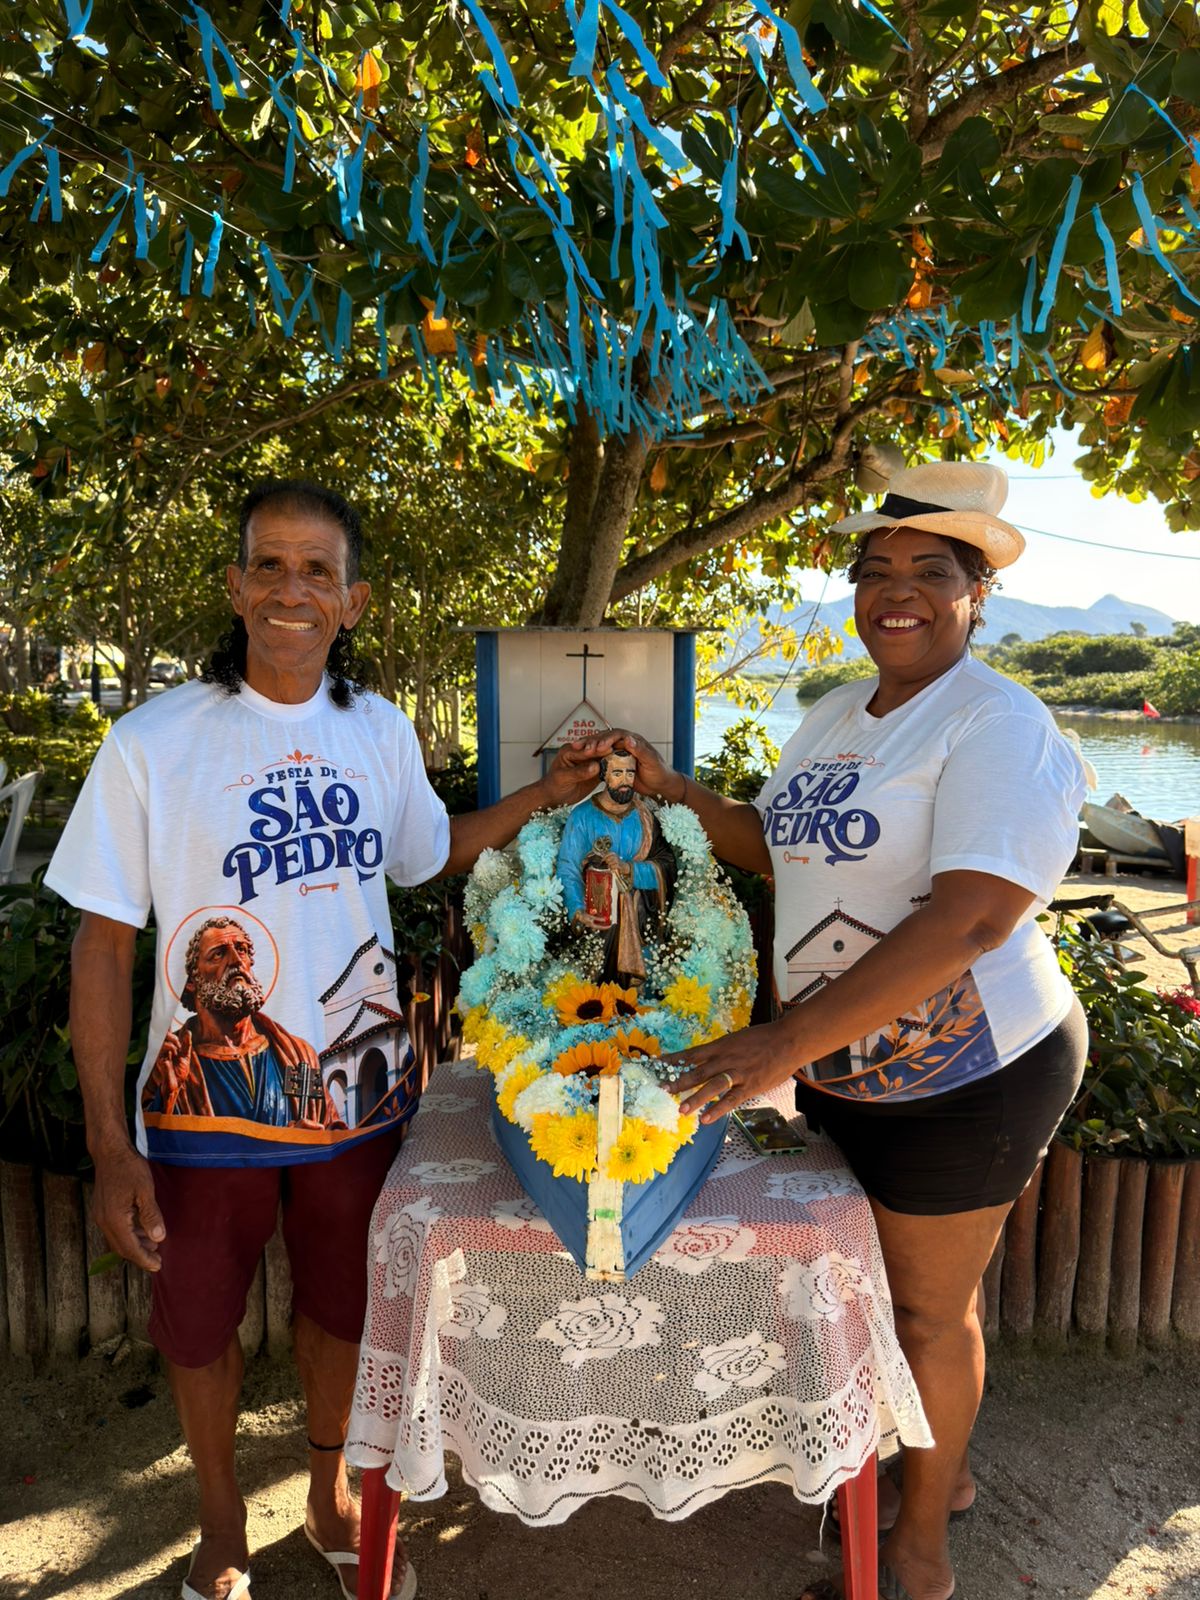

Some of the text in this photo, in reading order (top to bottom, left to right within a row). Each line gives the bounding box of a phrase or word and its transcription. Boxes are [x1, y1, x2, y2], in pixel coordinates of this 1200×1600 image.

[567, 729, 600, 737] PEDRO
[265, 766, 338, 784] FESTA DE
[772, 771, 860, 811] SÃO
[248, 779, 360, 842] SÃO
[222, 828, 383, 905] PEDRO
